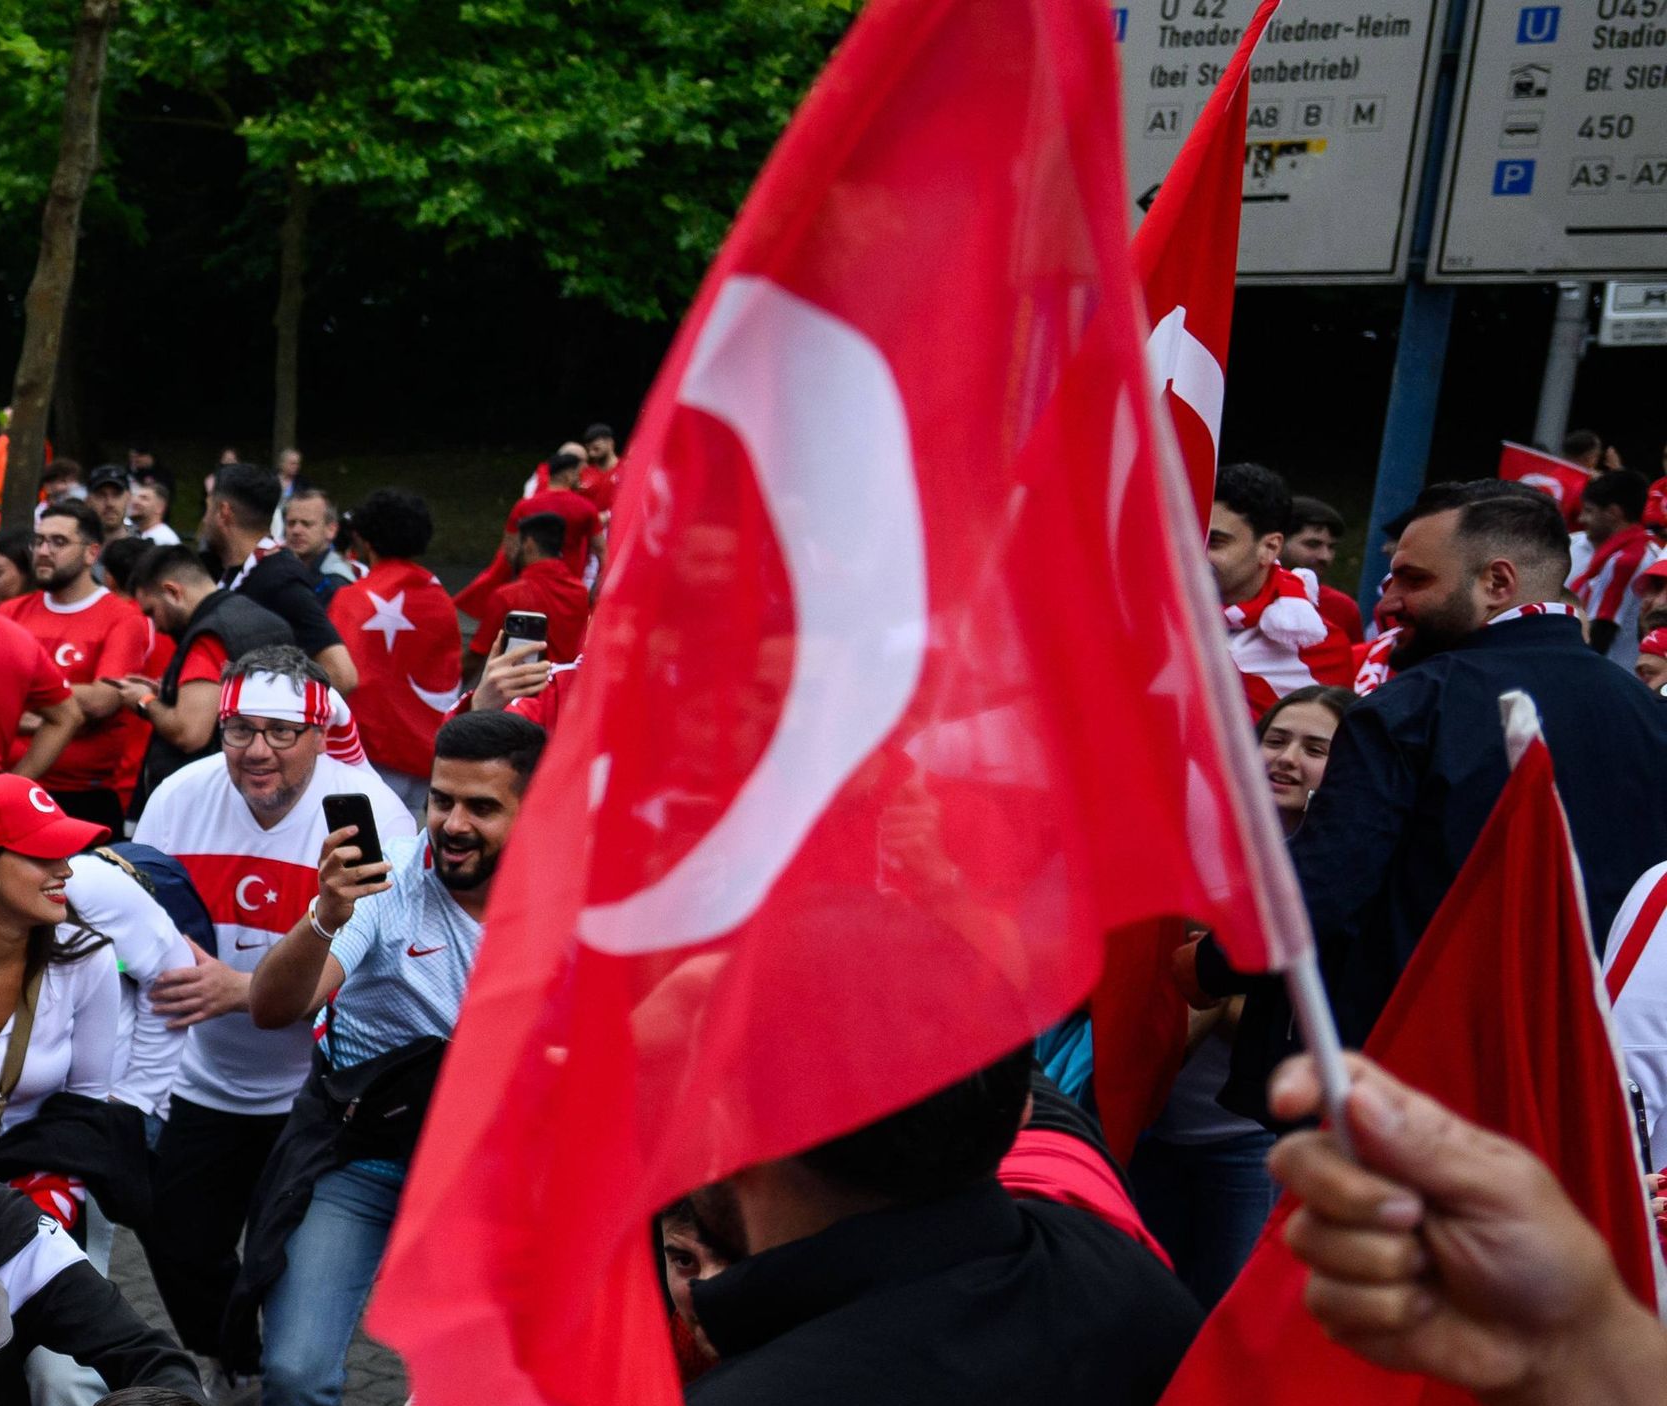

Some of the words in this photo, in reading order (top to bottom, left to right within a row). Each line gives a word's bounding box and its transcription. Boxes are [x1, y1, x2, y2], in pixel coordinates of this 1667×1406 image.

[1525, 11, 1551, 40] U
[1150, 64, 1188, 89] (bei
[1148, 110, 1178, 132] A1
[1304, 104, 1323, 126] B
[1353, 101, 1377, 124] M
[1578, 114, 1634, 139] 450
[1571, 164, 1610, 187] A3
